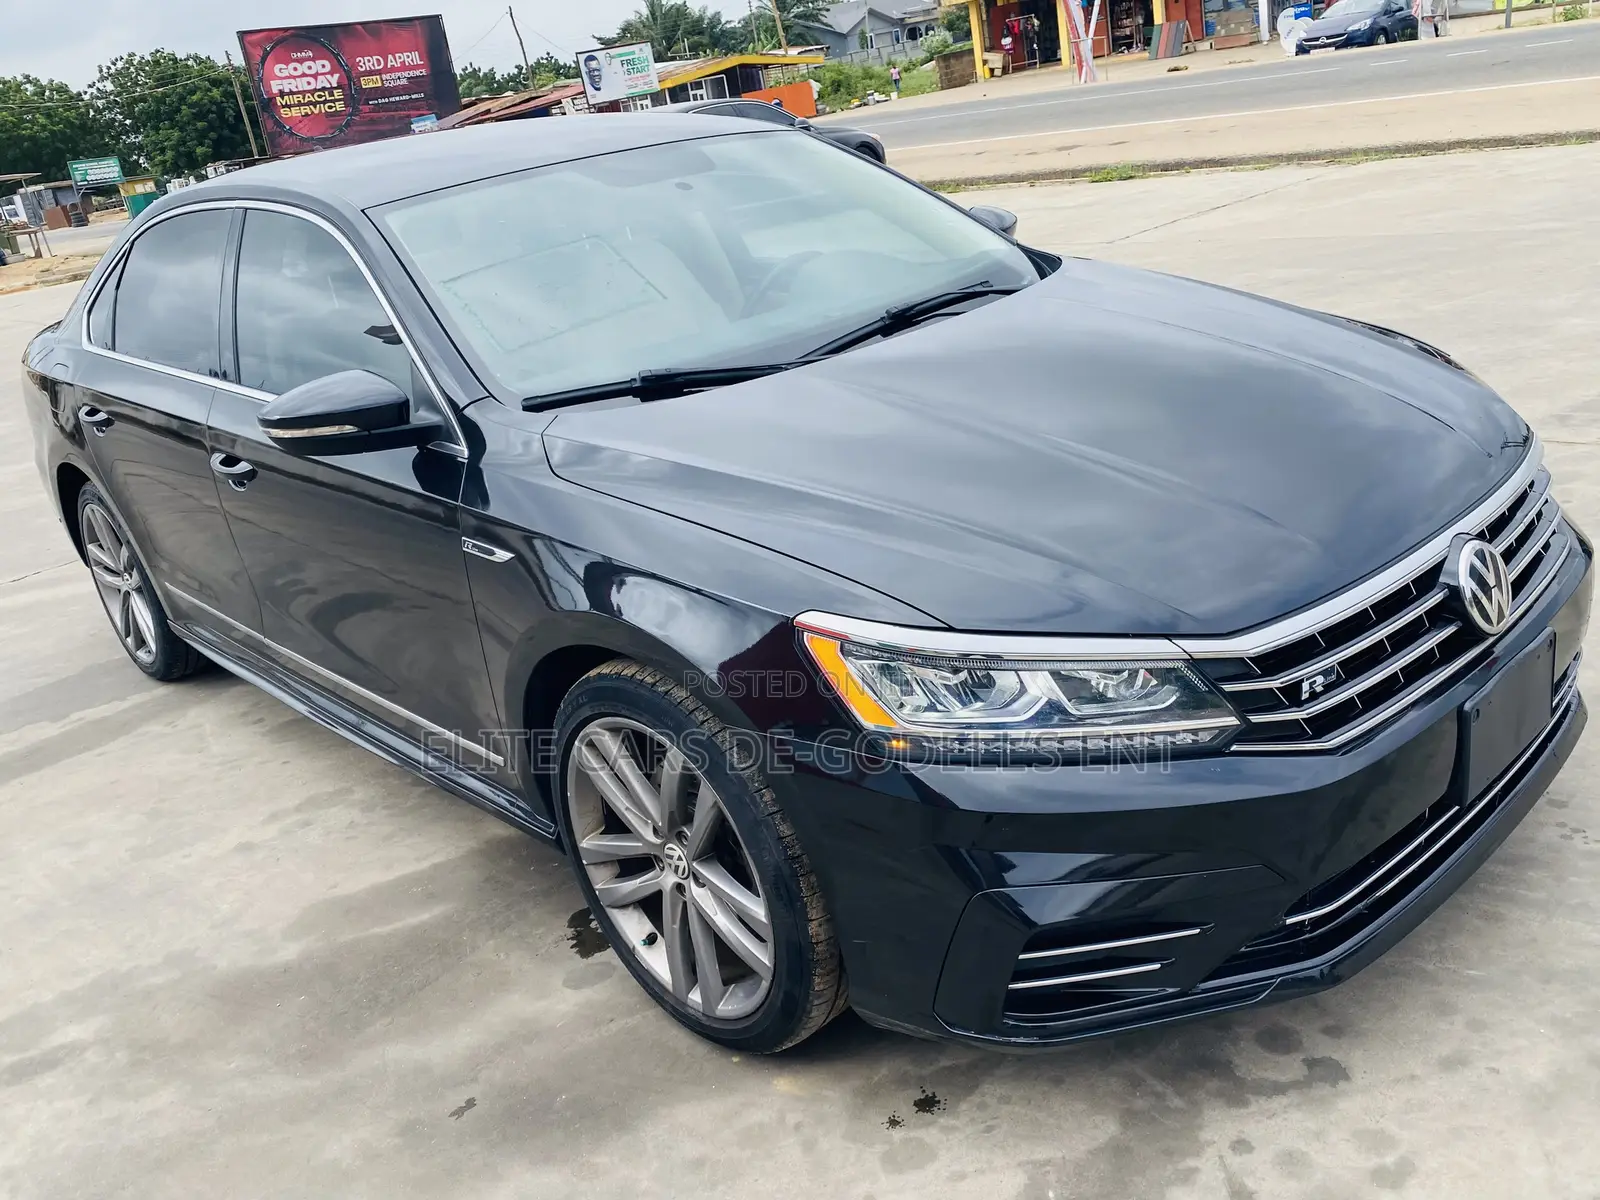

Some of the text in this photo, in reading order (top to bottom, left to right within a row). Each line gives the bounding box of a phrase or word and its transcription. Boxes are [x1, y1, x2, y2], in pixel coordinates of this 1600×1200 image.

[274, 59, 331, 78] GOOD
[355, 51, 424, 72] 3RD APRIL
[620, 55, 650, 68] FRESH
[381, 68, 428, 81] INDEPENDENCE
[626, 64, 650, 76] START
[270, 73, 340, 94] FRIDAY
[362, 76, 380, 87] 3PM
[383, 78, 409, 88] SQUARE
[276, 89, 344, 106] MIRACLE
[280, 101, 345, 118] SERVICE
